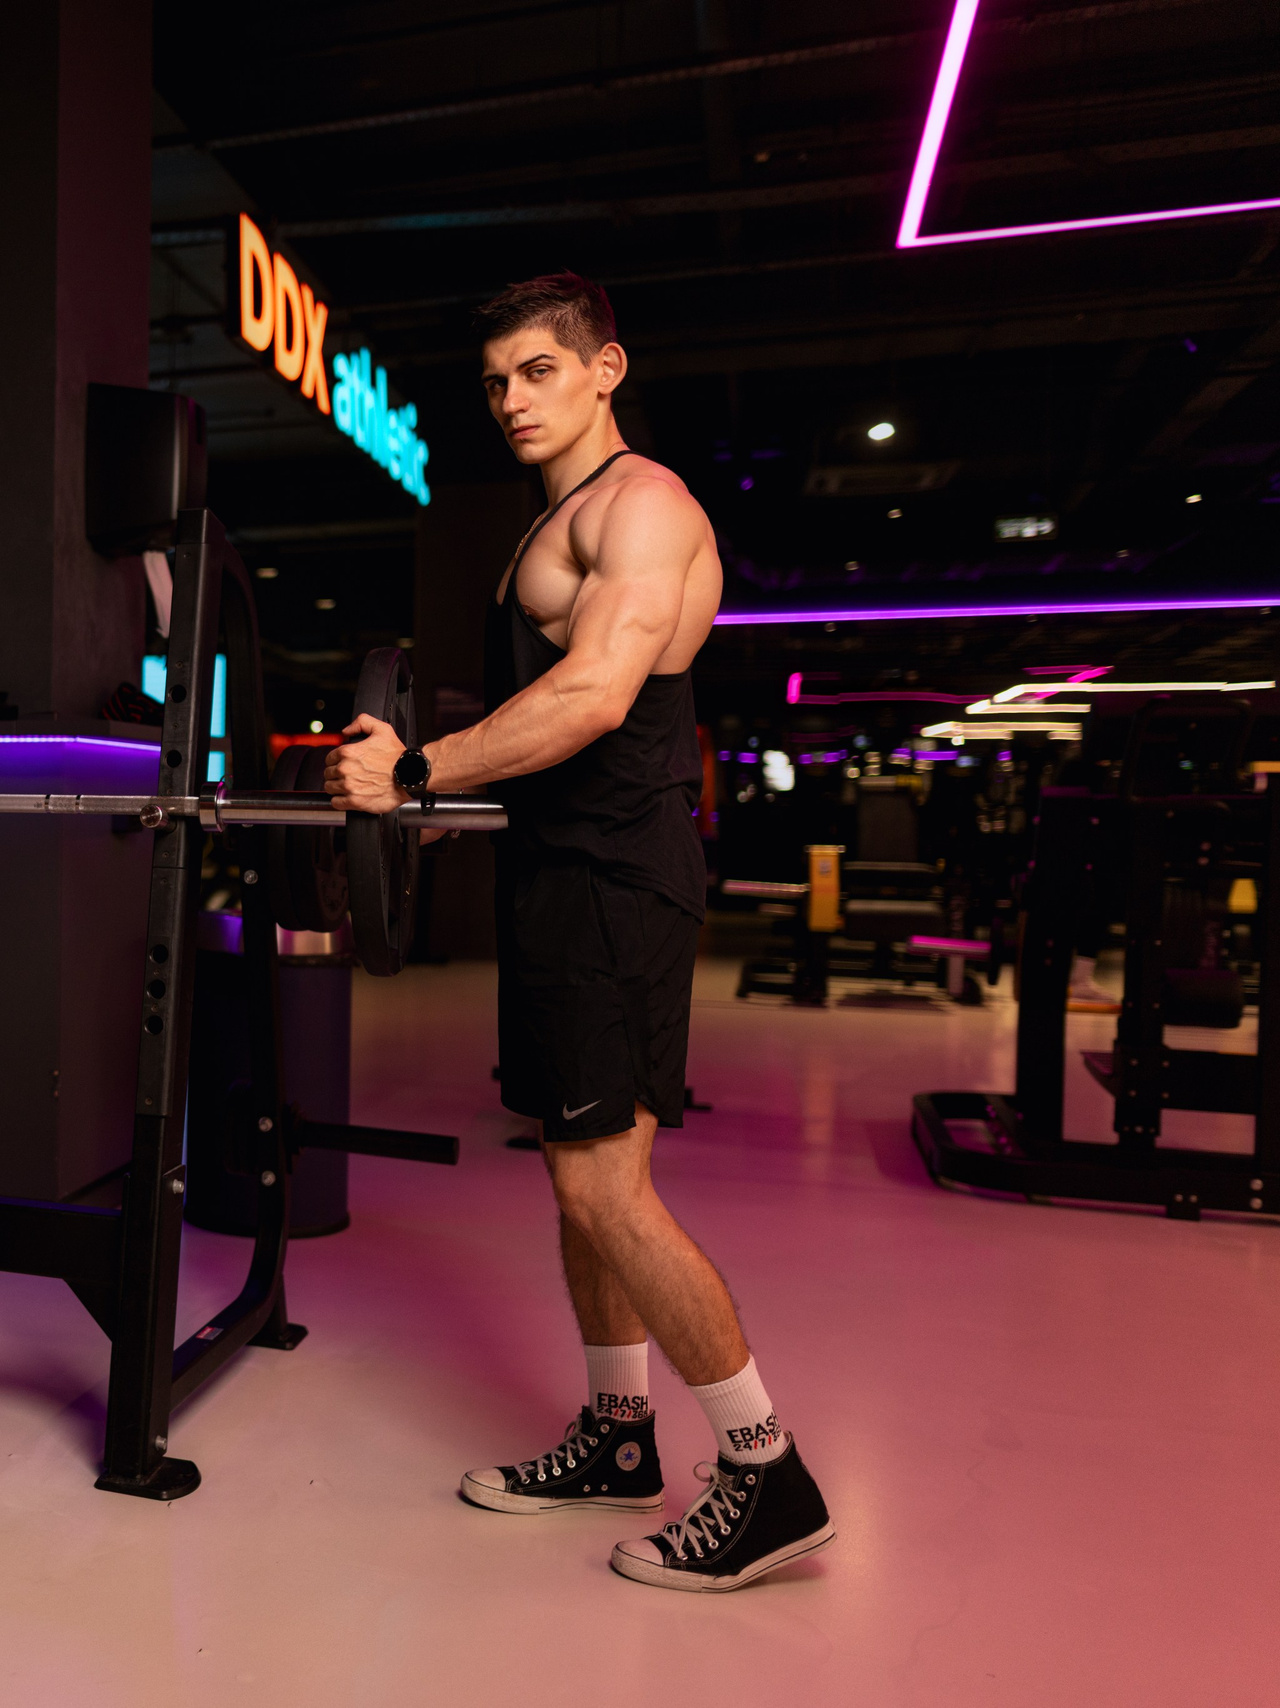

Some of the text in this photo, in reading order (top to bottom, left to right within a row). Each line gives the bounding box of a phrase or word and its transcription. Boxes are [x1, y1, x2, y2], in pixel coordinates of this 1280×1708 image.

[239, 211, 431, 508] DDX athletic
[597, 1392, 648, 1410] EBASH
